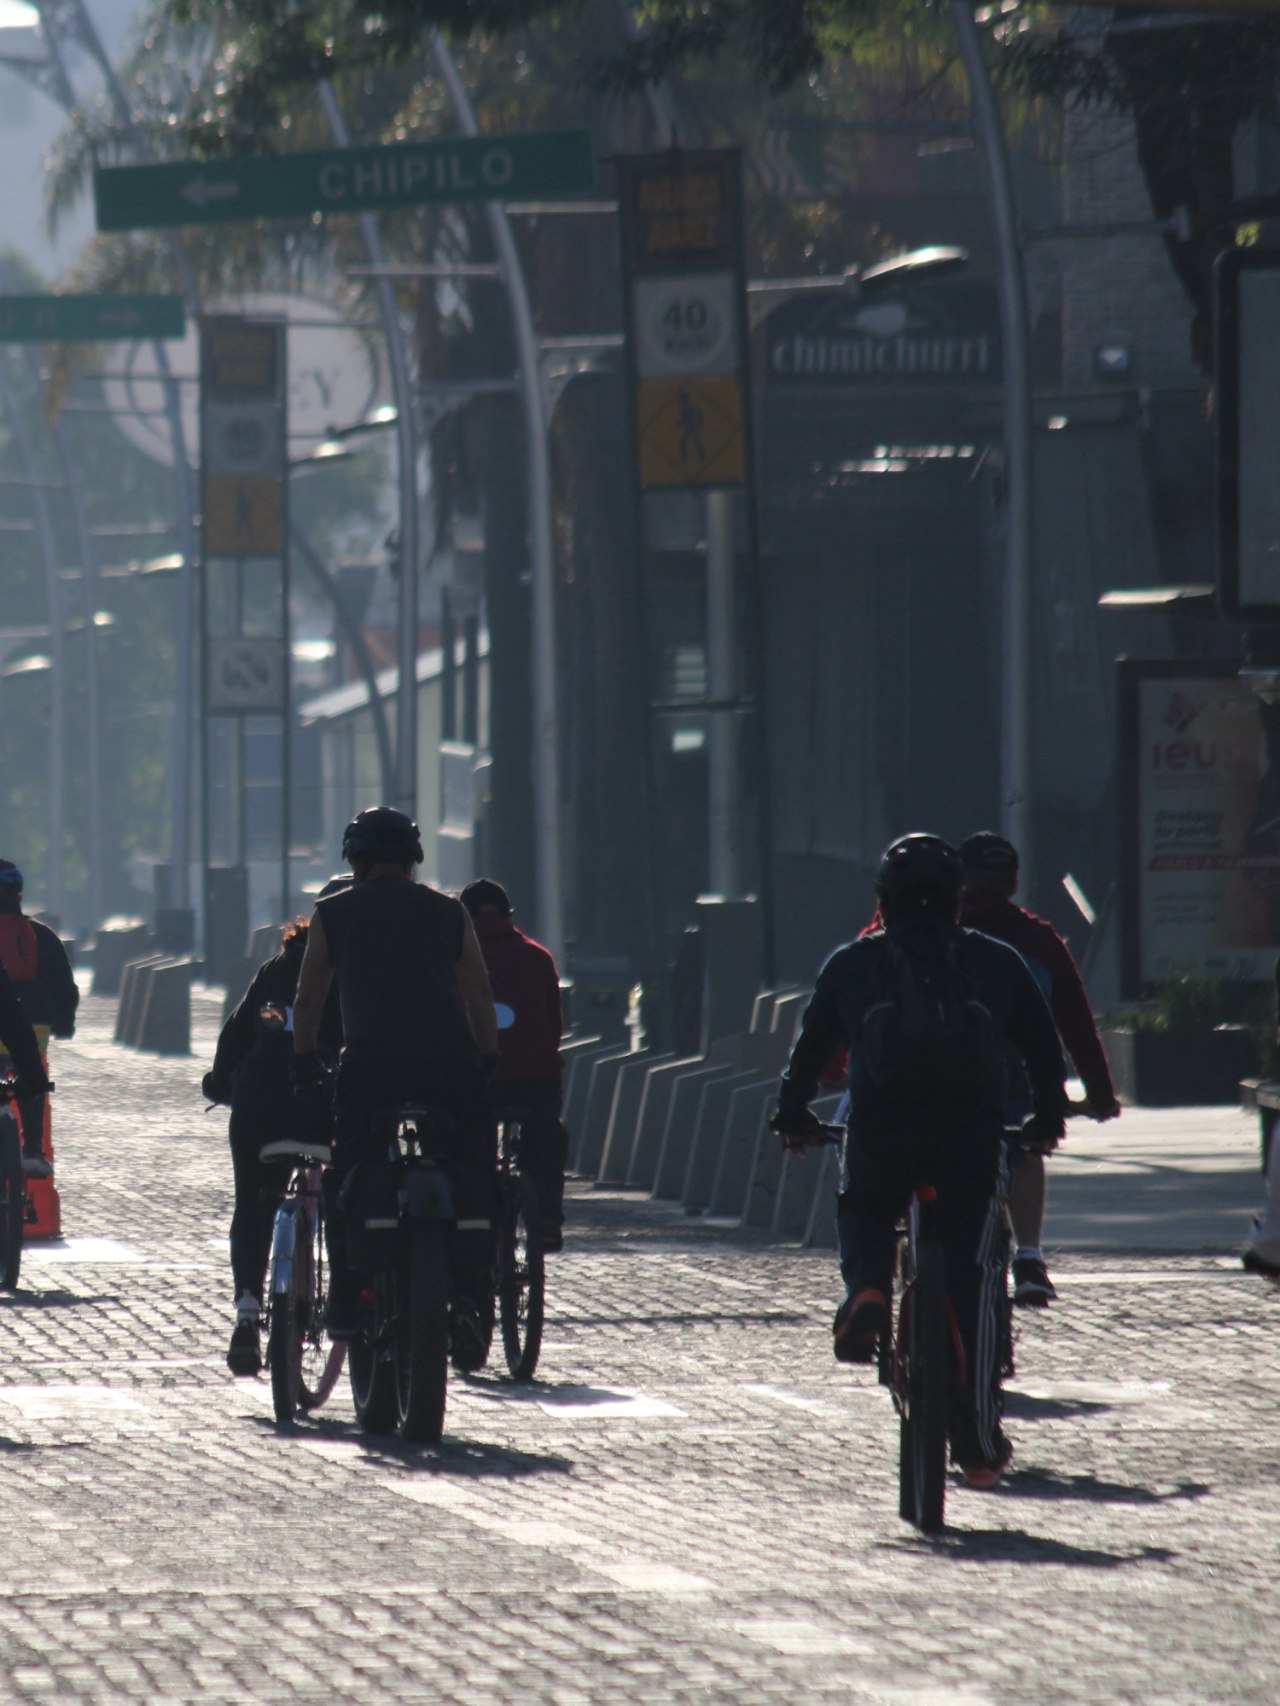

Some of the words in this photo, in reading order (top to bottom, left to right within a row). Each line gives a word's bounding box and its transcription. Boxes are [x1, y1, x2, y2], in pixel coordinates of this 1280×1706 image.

[320, 149, 513, 200] CHIPILO
[663, 298, 708, 331] 40
[772, 334, 991, 373] chimichurri
